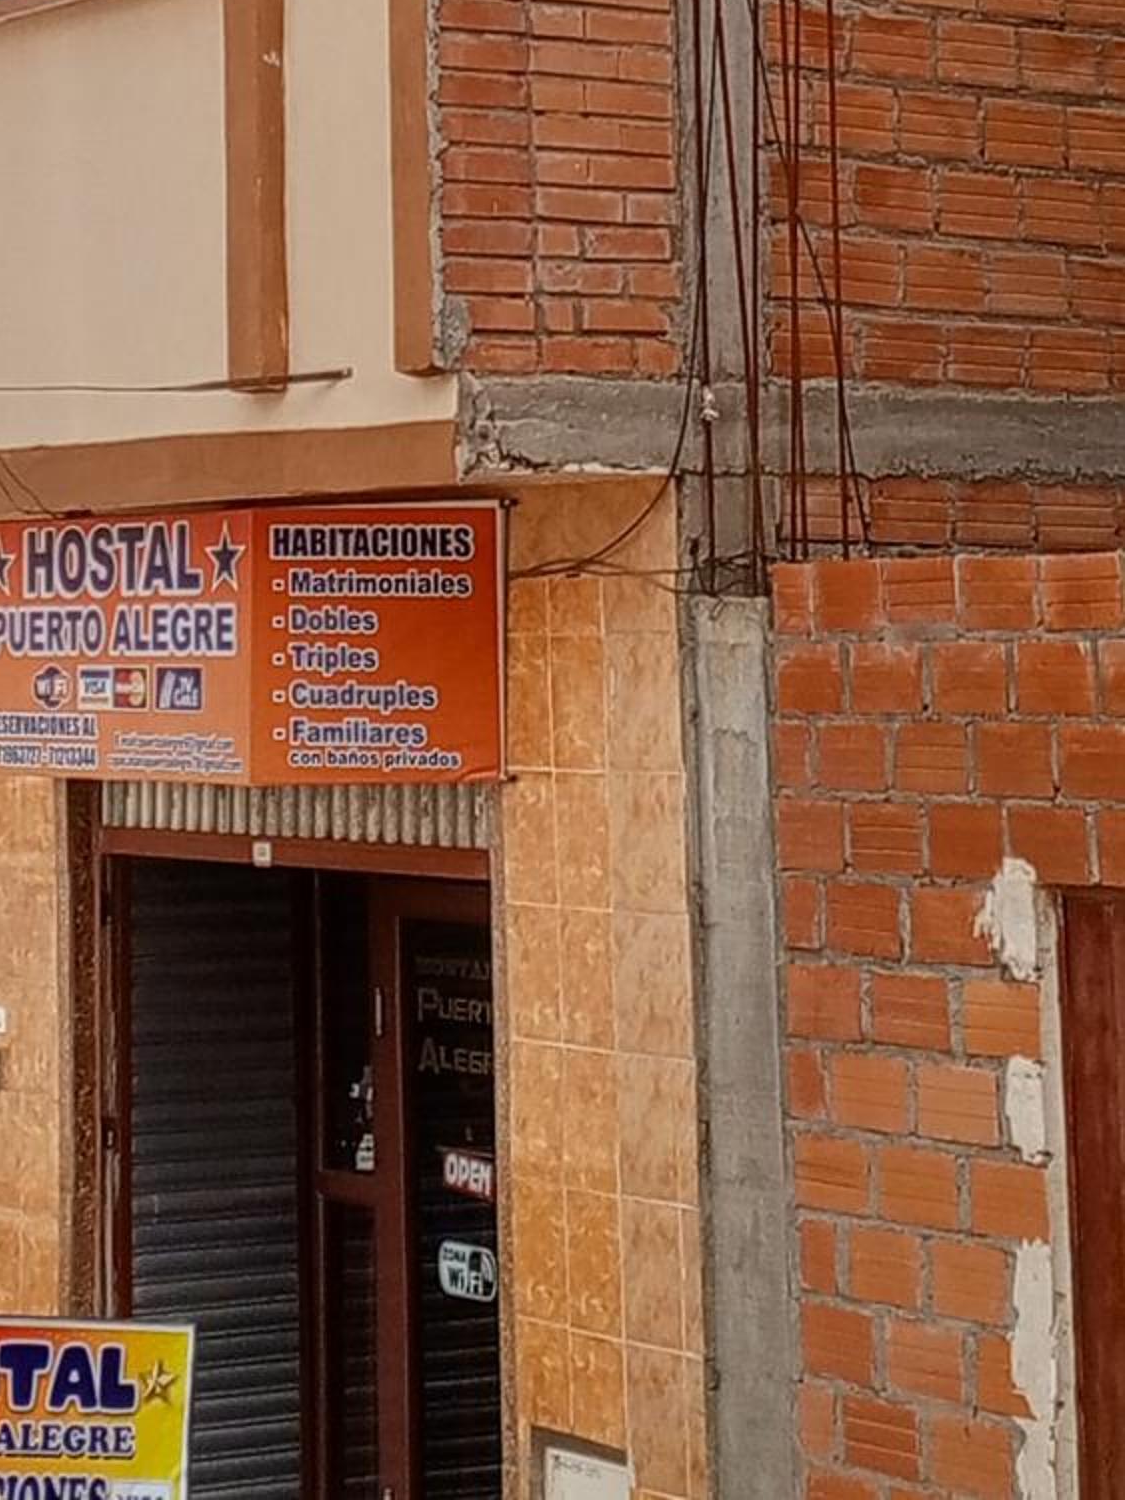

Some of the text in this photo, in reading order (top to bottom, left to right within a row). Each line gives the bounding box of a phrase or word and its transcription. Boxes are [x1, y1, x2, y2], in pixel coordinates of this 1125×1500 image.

[271, 526, 473, 558] HABITACIONES
[25, 524, 202, 594] HOSTAL
[290, 571, 471, 596] Matrimoniales
[112, 606, 235, 652] ALEGRE
[290, 607, 377, 632] Dobles
[290, 645, 377, 673] Triples
[290, 683, 436, 711] Cuadruples
[82, 716, 96, 737] AL
[290, 720, 425, 745] Familiares
[289, 749, 460, 771] con baños privados
[443, 1152, 493, 1196] OPEN
